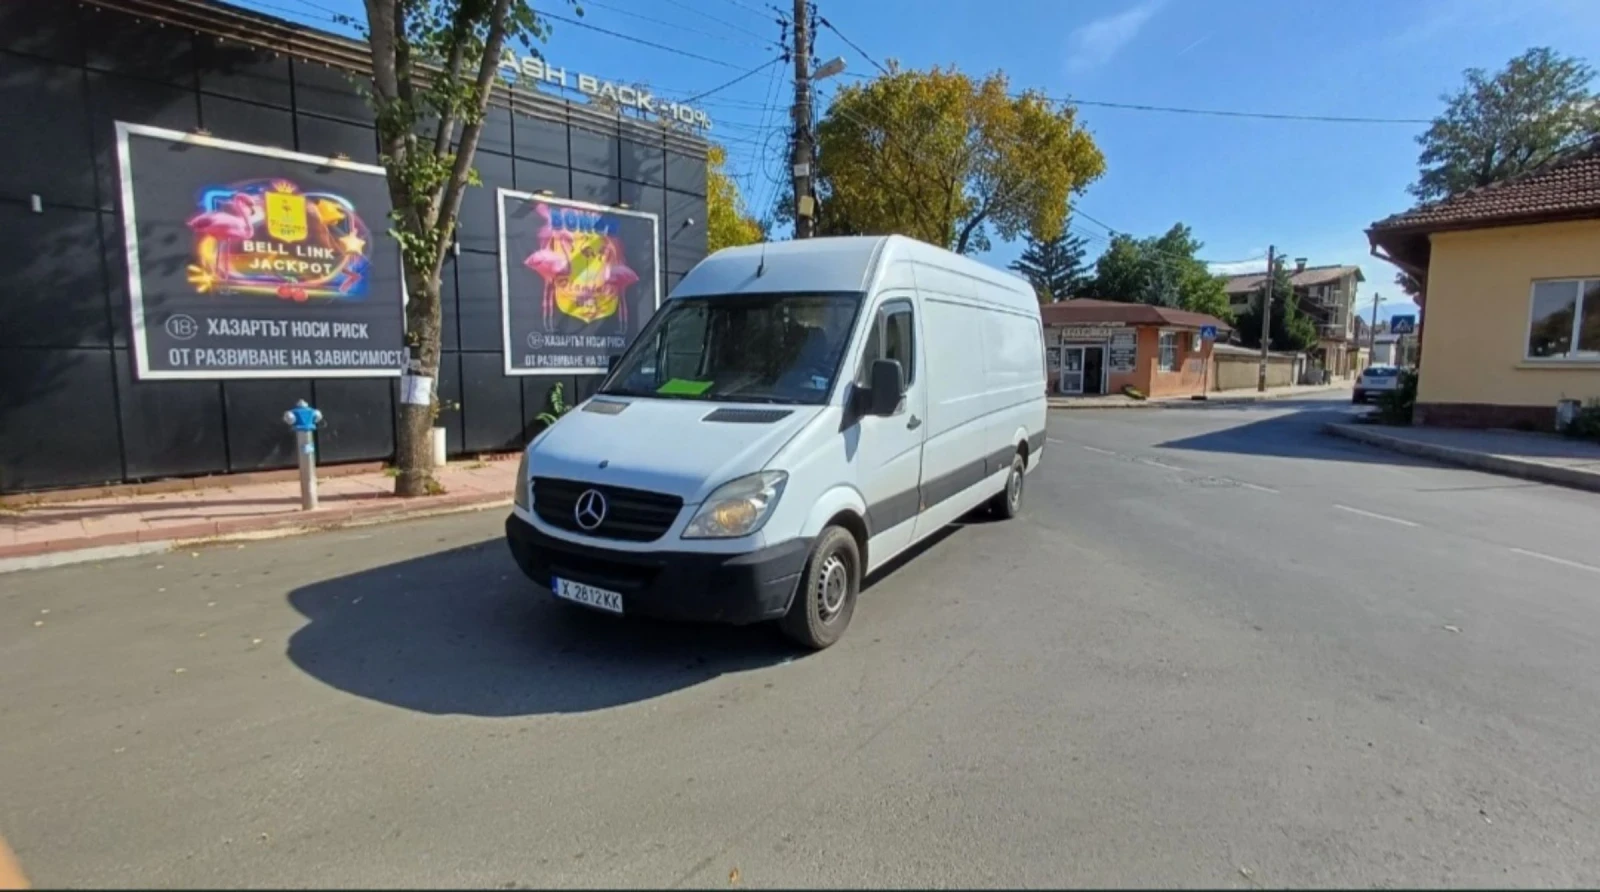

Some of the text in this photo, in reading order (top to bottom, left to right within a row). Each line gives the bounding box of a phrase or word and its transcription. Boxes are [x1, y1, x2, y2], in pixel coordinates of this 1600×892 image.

[497, 50, 713, 130] ASH BACK -10%
[243, 240, 335, 259] BELL LINK
[249, 258, 333, 274] JACKPOT
[207, 318, 288, 337] ХАЗАРТЪТ
[292, 320, 330, 338] НОСИ
[333, 322, 369, 339] РИСК
[169, 348, 402, 366] ОТ РАЗВИВАНЕ НА ЗАВИСИМОСТ
